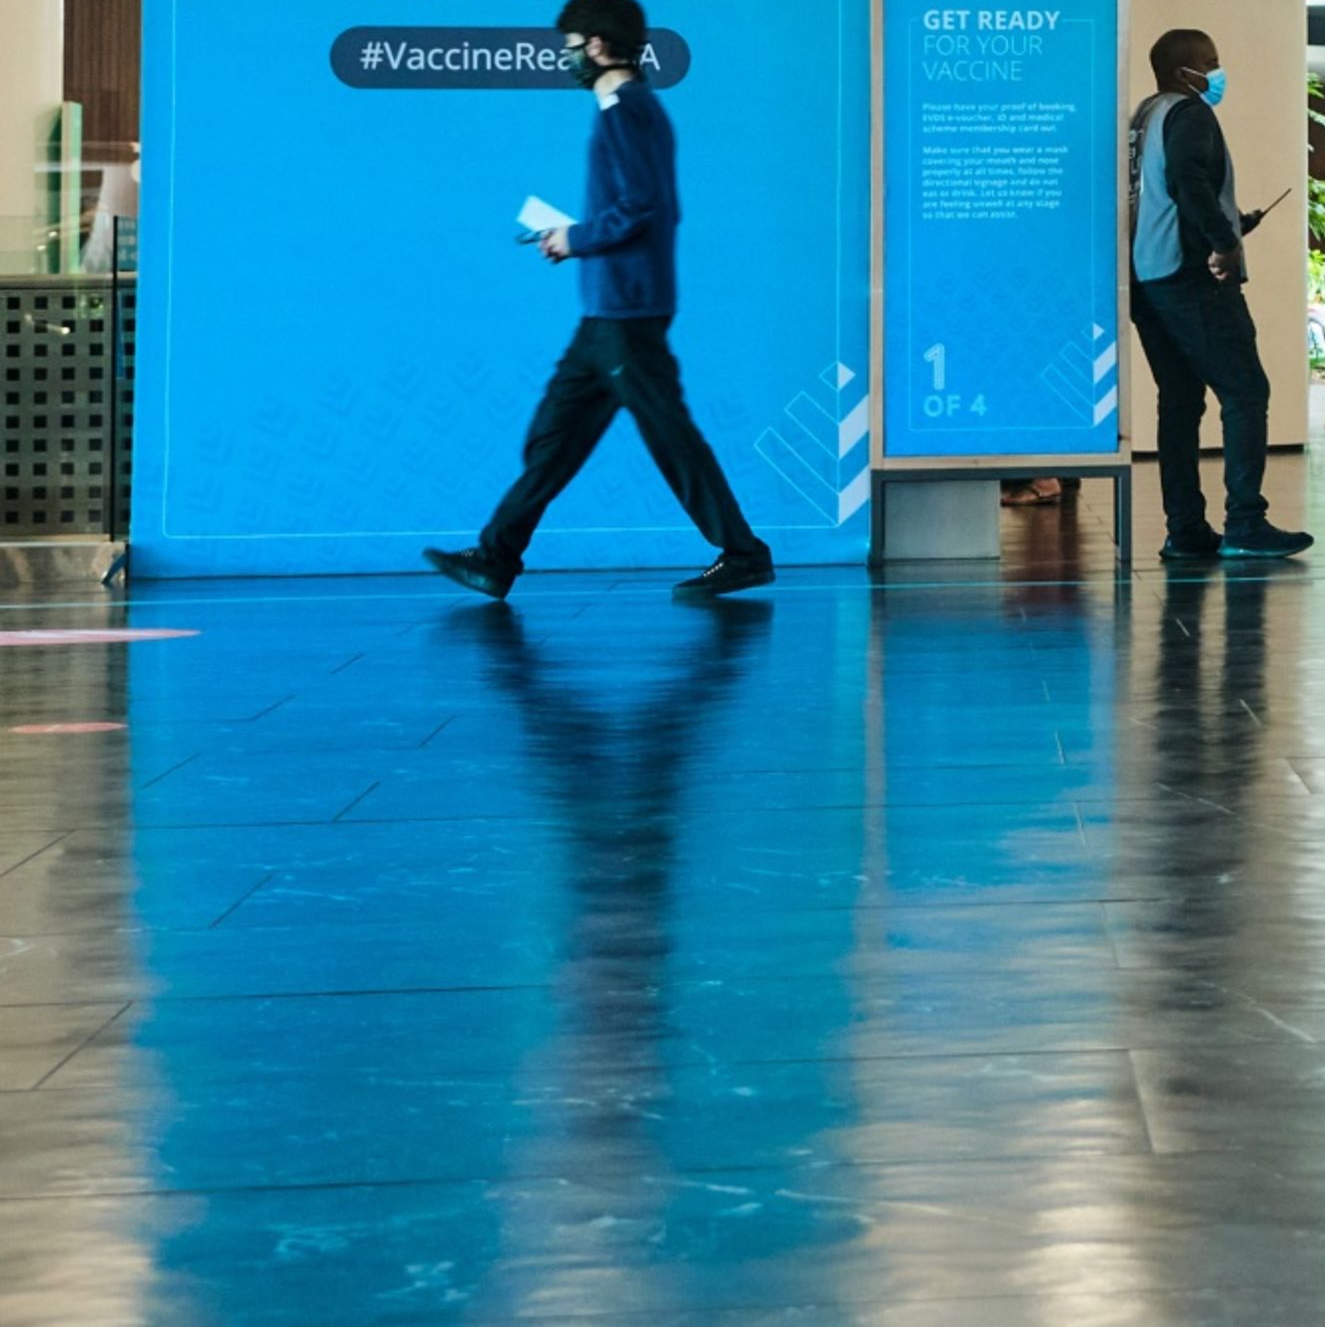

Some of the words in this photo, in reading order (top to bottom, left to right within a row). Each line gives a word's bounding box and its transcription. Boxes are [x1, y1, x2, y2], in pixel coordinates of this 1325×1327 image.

[923, 10, 970, 31] GET
[978, 10, 1061, 31] READY
[923, 35, 970, 56] FOR
[976, 35, 1043, 56] YOUR
[360, 42, 660, 73] #VaccineReaA
[922, 60, 1023, 81] VACCINE
[923, 342, 946, 391] 1
[923, 395, 961, 417] OF
[969, 394, 988, 416] 4
